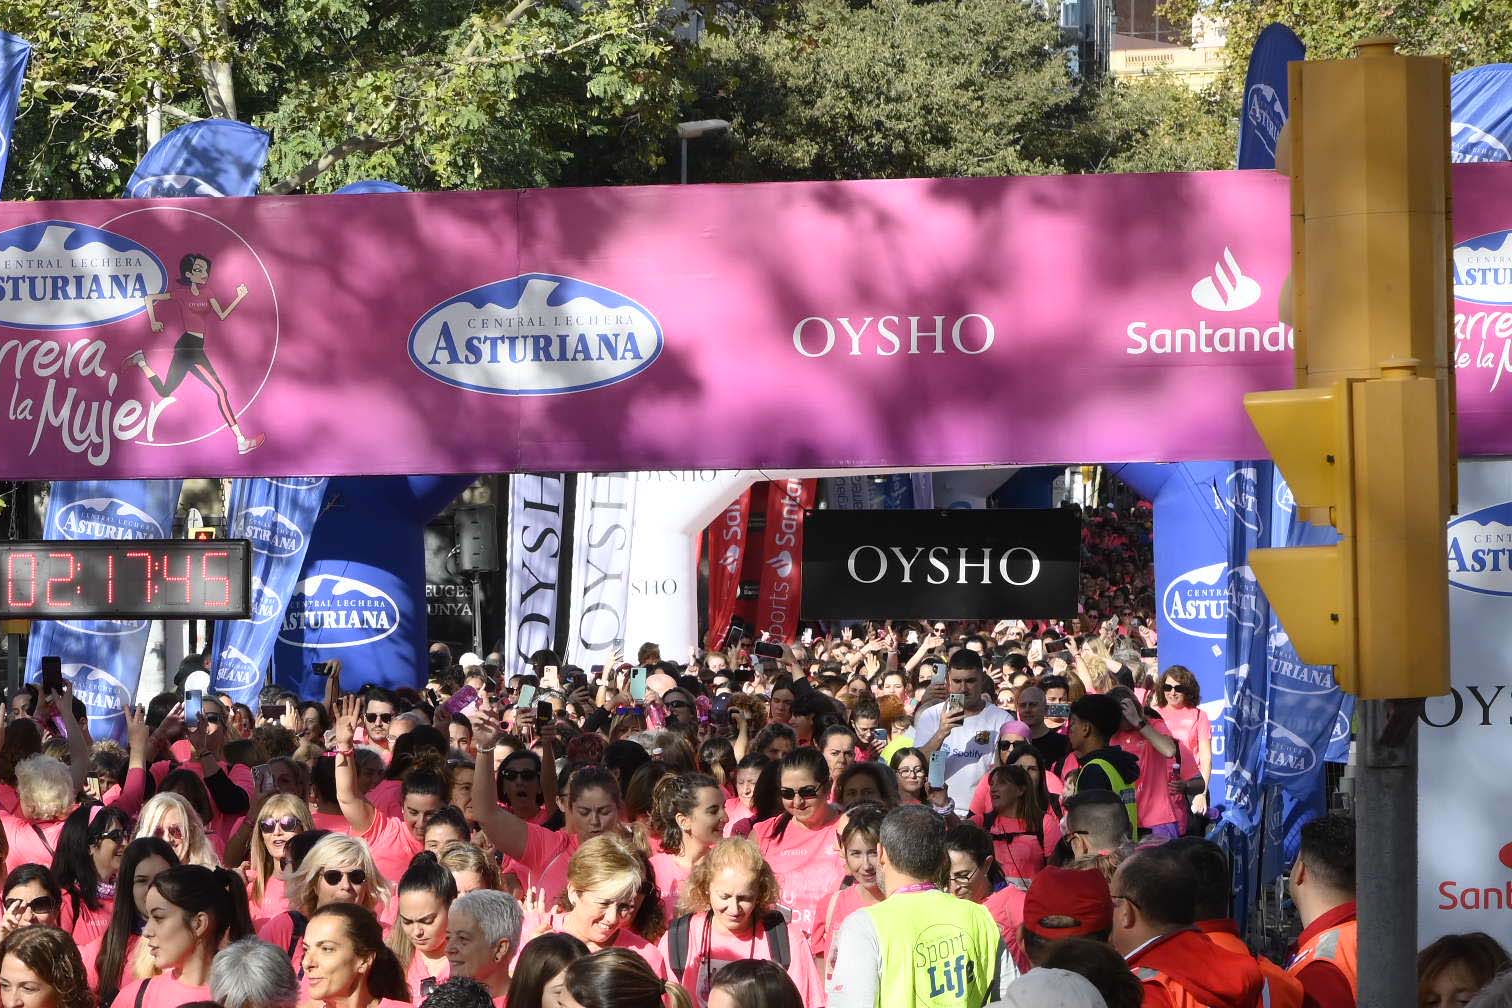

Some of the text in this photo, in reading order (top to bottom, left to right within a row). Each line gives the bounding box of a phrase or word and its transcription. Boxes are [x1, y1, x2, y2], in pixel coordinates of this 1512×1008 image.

[71, 256, 143, 269] LECHERA
[466, 313, 635, 330] CENTRAL LECHERA
[792, 314, 996, 358] OYSHO
[428, 320, 643, 366] ASTURIANA
[1476, 340, 1495, 369] la
[8, 383, 34, 421] la
[28, 373, 177, 467] Mujer
[7, 552, 231, 608] 02:17:45
[847, 545, 1041, 587] OYSHO
[280, 609, 390, 632] ASTURIANA
[337, 599, 386, 608] LECHERA
[952, 747, 983, 760] Spotify
[915, 930, 969, 968] Sport
[927, 954, 975, 1000] Life
